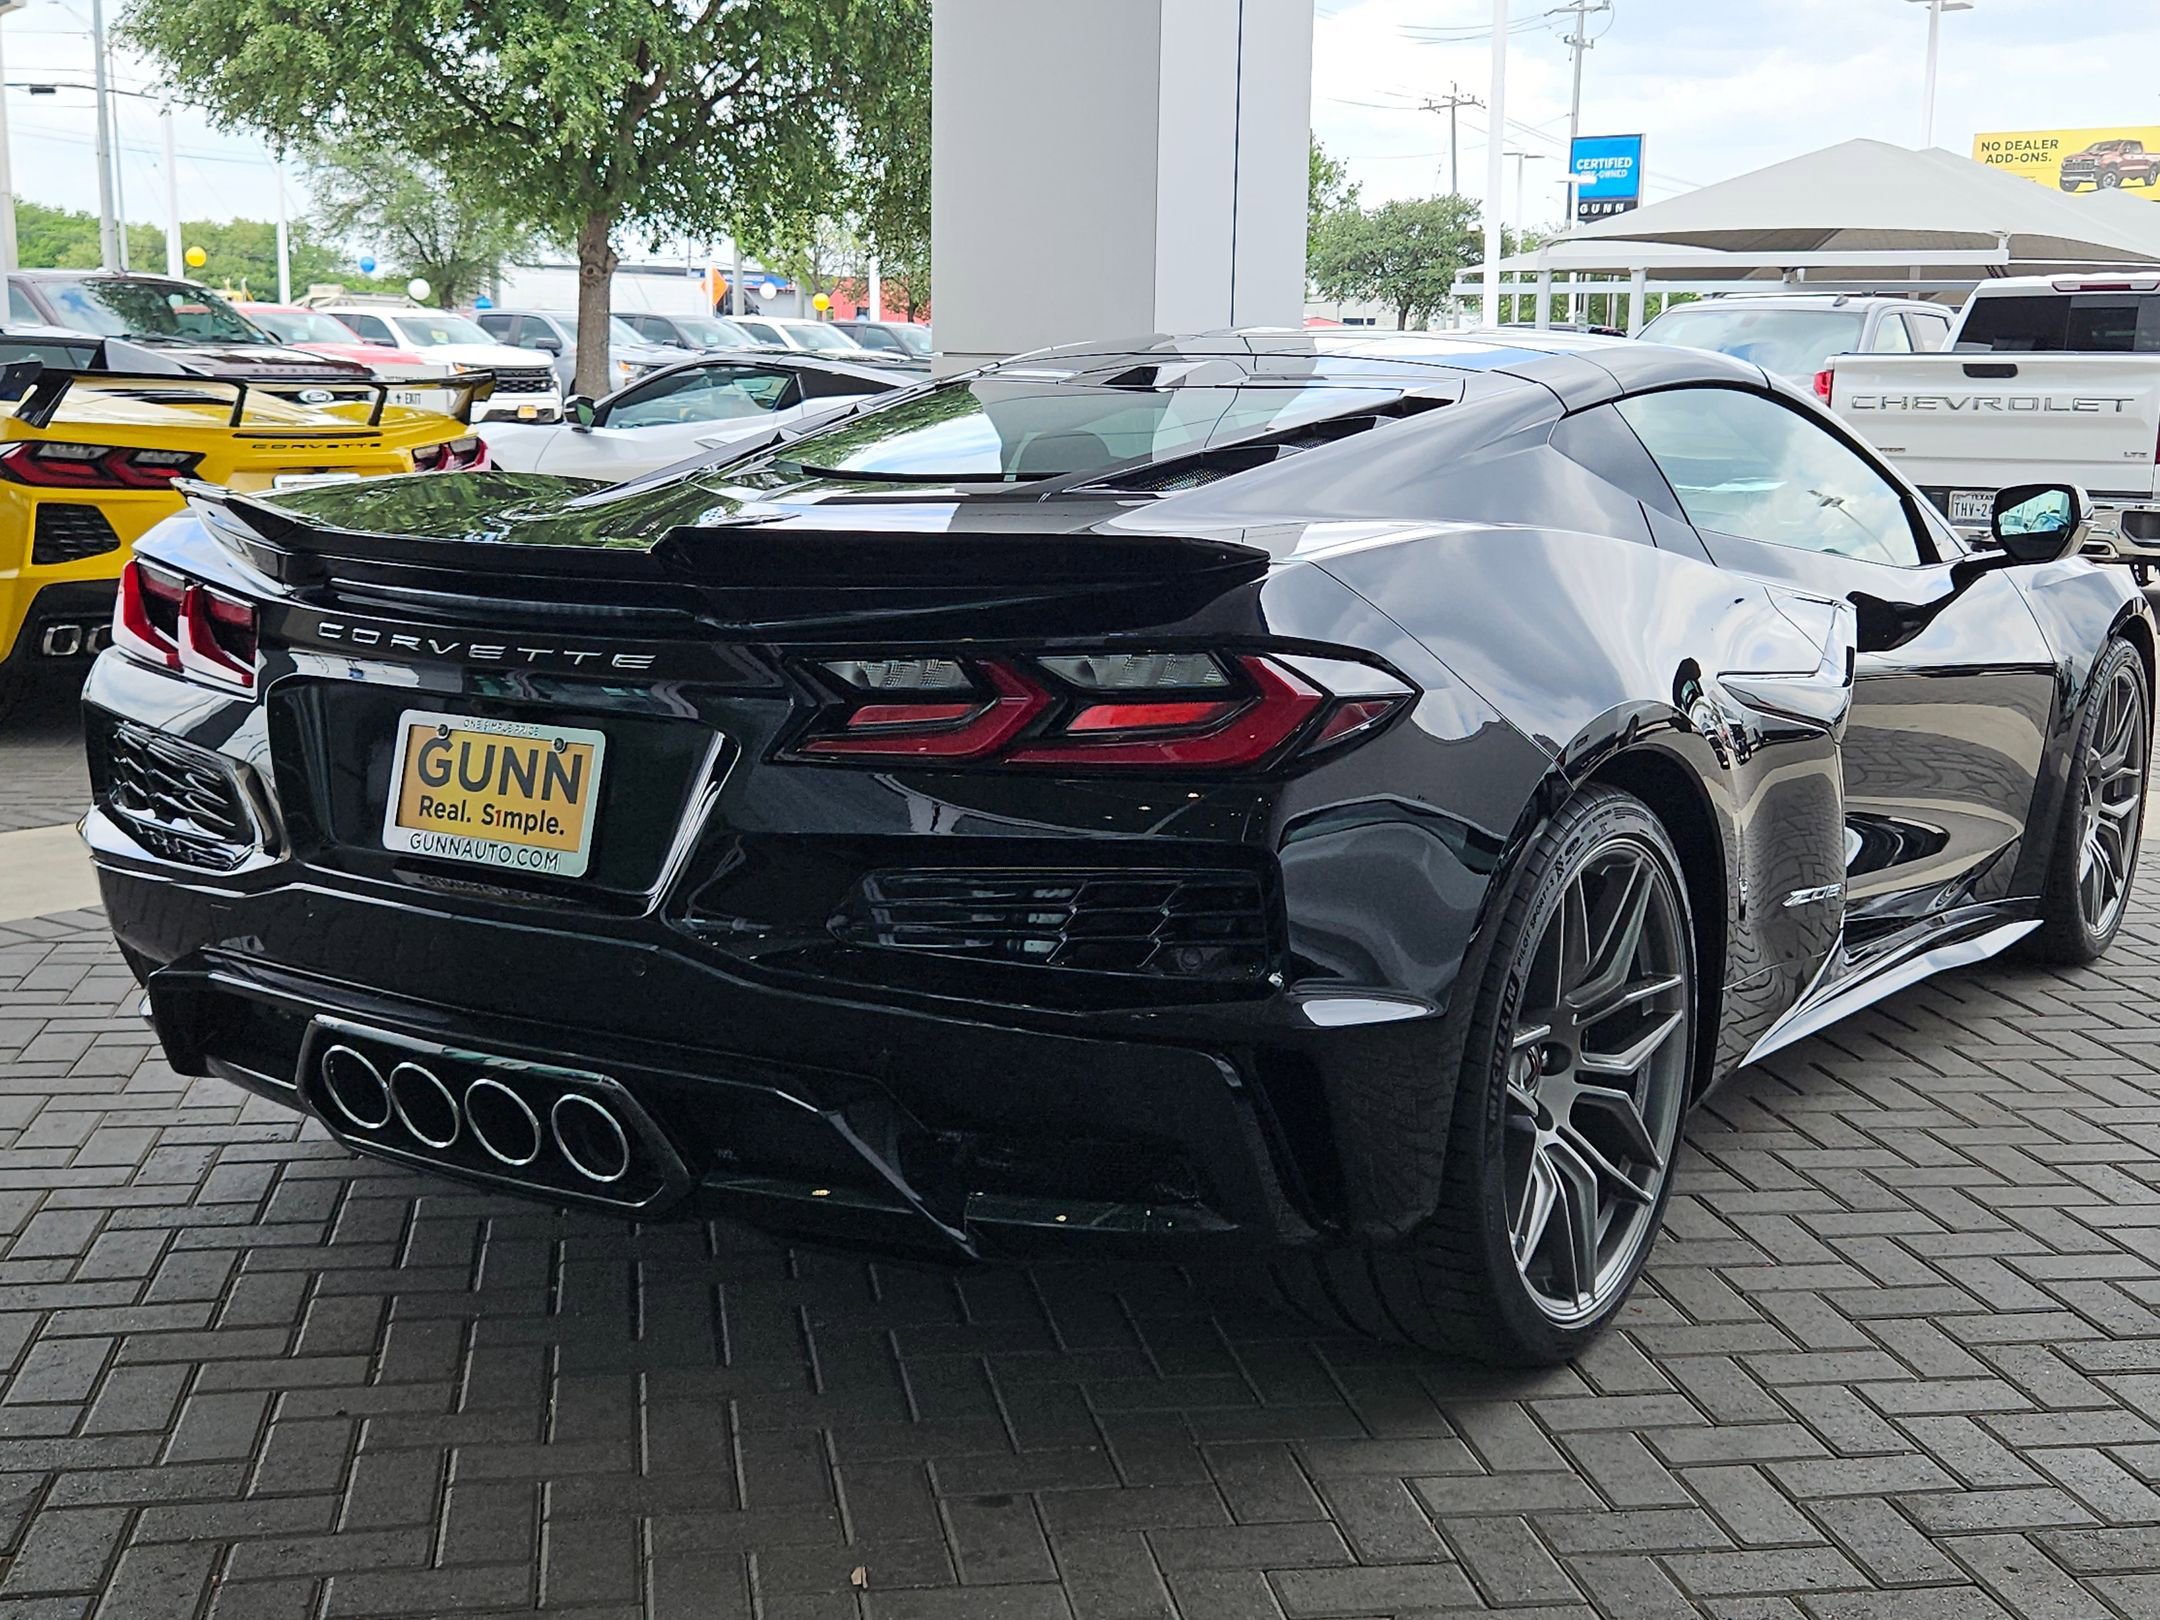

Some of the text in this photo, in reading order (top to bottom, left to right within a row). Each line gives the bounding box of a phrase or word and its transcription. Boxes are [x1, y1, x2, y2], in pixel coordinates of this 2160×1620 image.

[1981, 139, 2059, 152] NO DEALER
[1577, 158, 1633, 170] CERTIFIED
[1985, 153, 2052, 164] ADD-ONS.
[1579, 203, 1624, 214] GUNN
[1851, 396, 2135, 412] CHEVROLET
[317, 622, 657, 669] CORVETTE
[417, 737, 583, 804] GUNN
[418, 795, 471, 823] Real.
[409, 833, 560, 871] GUNNAUTO.COM
[1782, 883, 1841, 907] Z06
[1488, 981, 1517, 1121] MICHELIN
